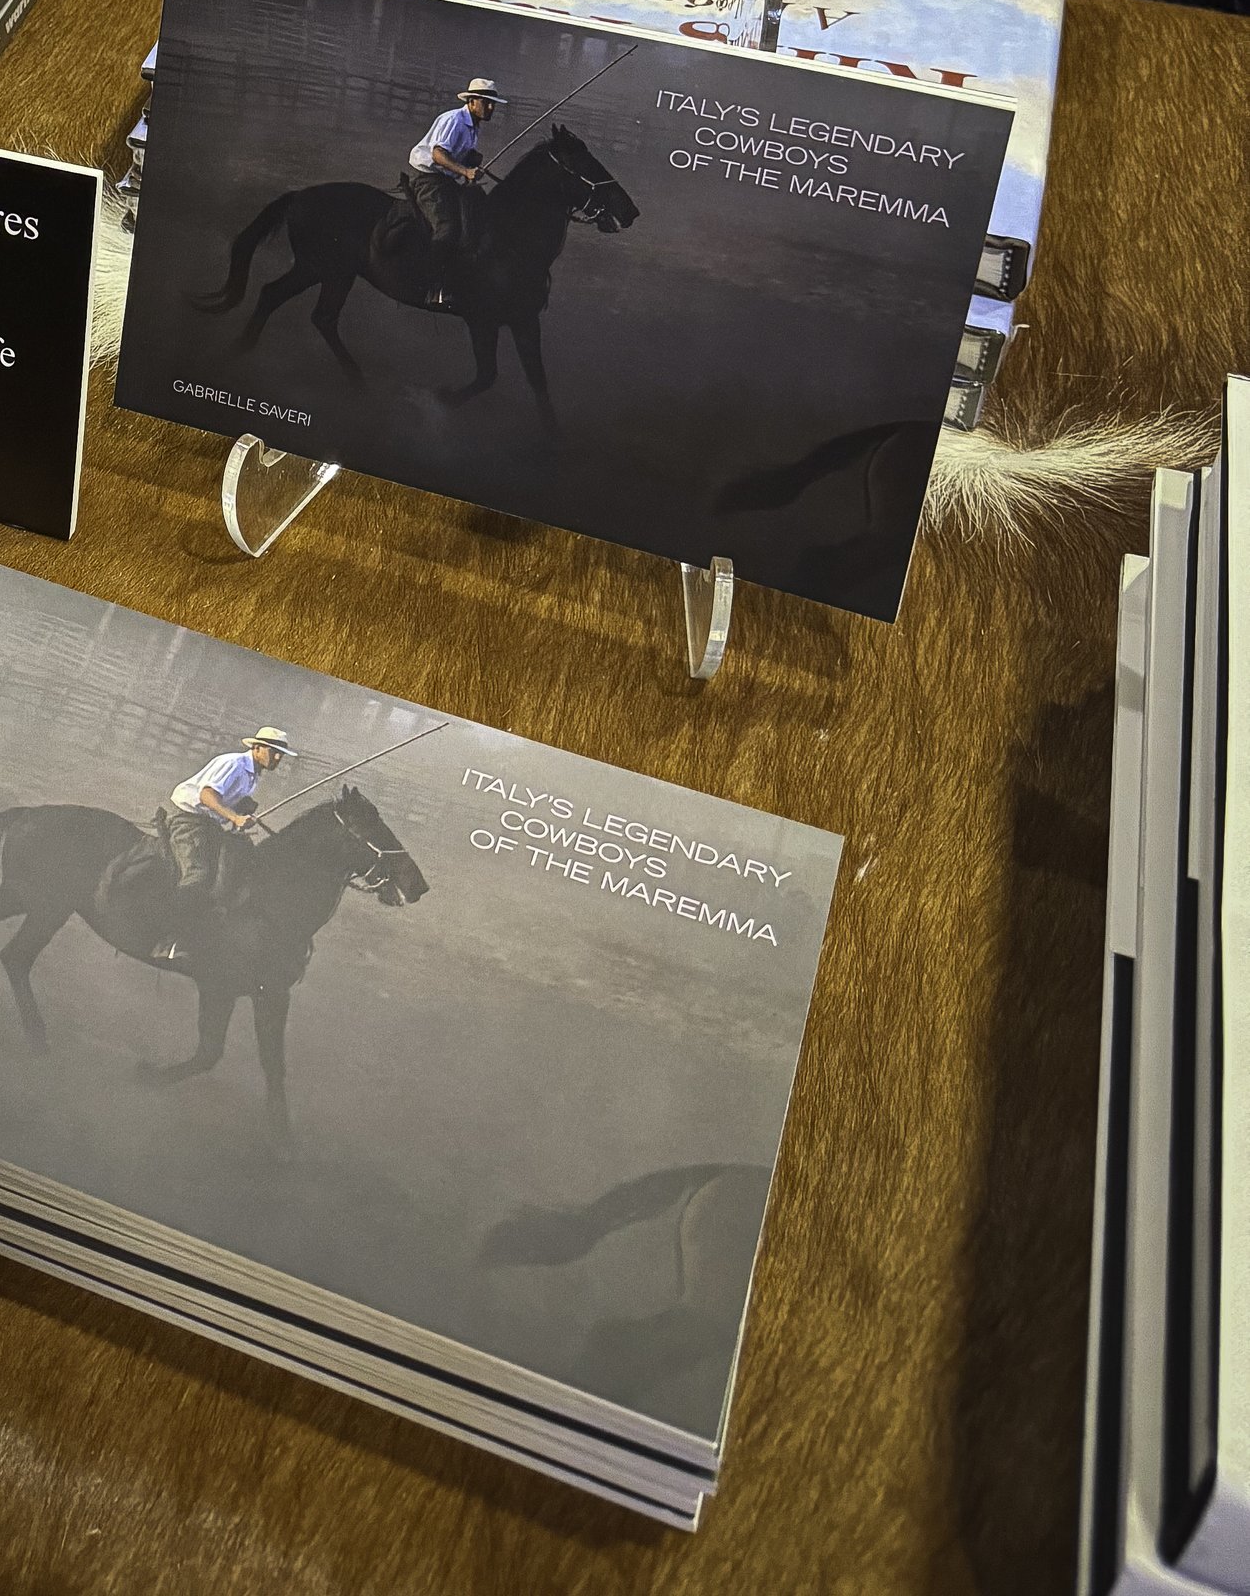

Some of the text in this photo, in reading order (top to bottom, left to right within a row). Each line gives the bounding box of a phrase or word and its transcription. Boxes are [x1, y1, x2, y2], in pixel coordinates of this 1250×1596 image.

[656, 90, 965, 169] ITALY'S LEGENDARY
[695, 127, 848, 174] COWBOYS
[669, 150, 950, 228] OF THE MAREMMA
[173, 380, 311, 426] GABRIELLE SAVERI
[462, 768, 792, 888] ITALY'S LEGENDARY
[501, 810, 667, 878] COWBOYS
[470, 829, 778, 947] OF THE MAREMMA
